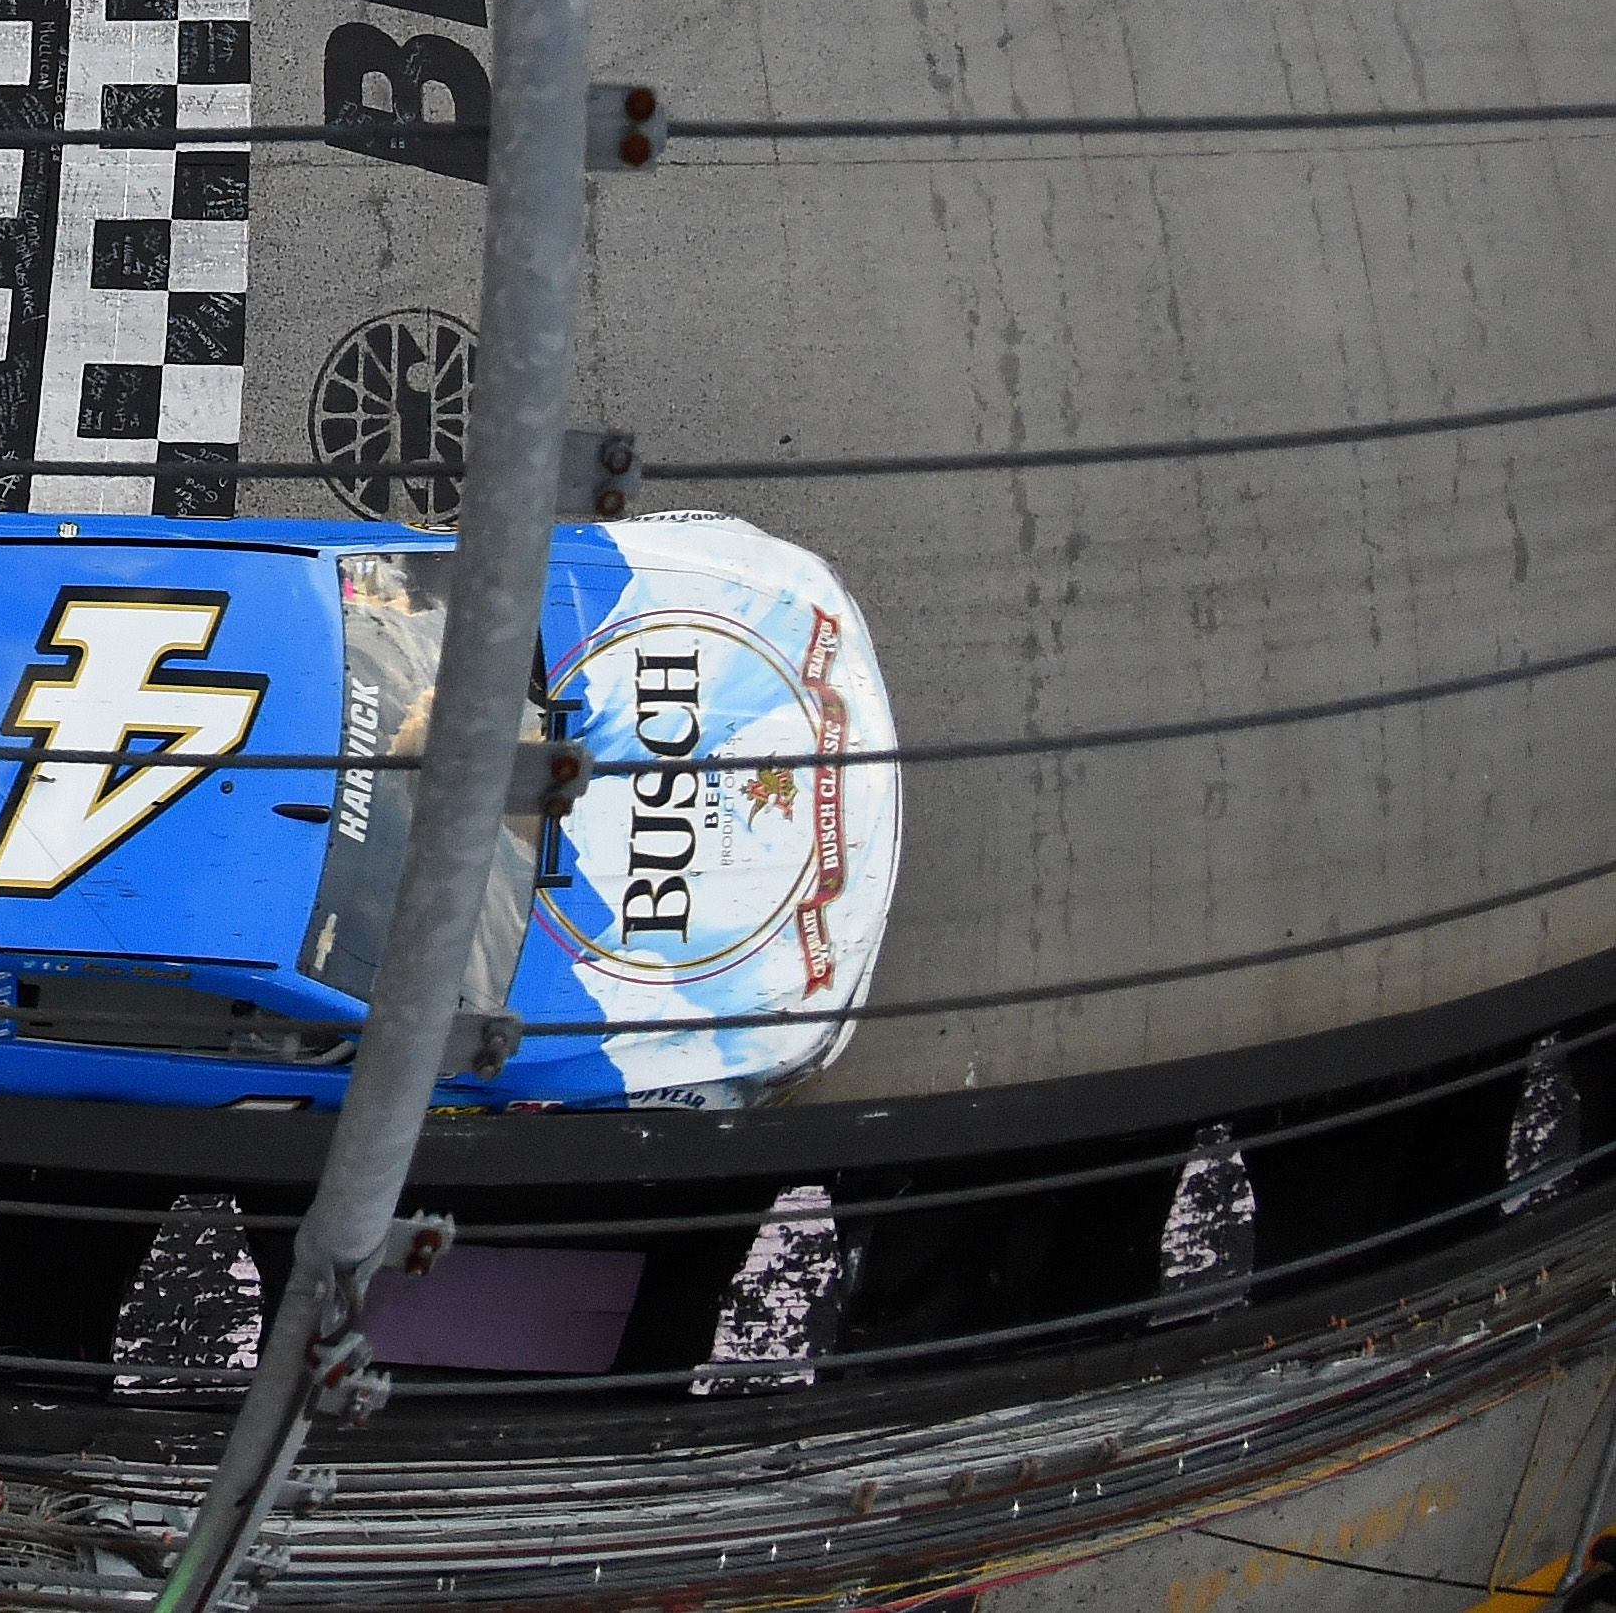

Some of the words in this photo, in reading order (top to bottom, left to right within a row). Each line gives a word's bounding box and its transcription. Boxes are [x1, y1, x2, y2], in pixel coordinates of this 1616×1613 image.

[338, 680, 381, 844] HARVICK
[622, 648, 701, 946] BUSCH
[821, 804, 839, 871] BUSCH
